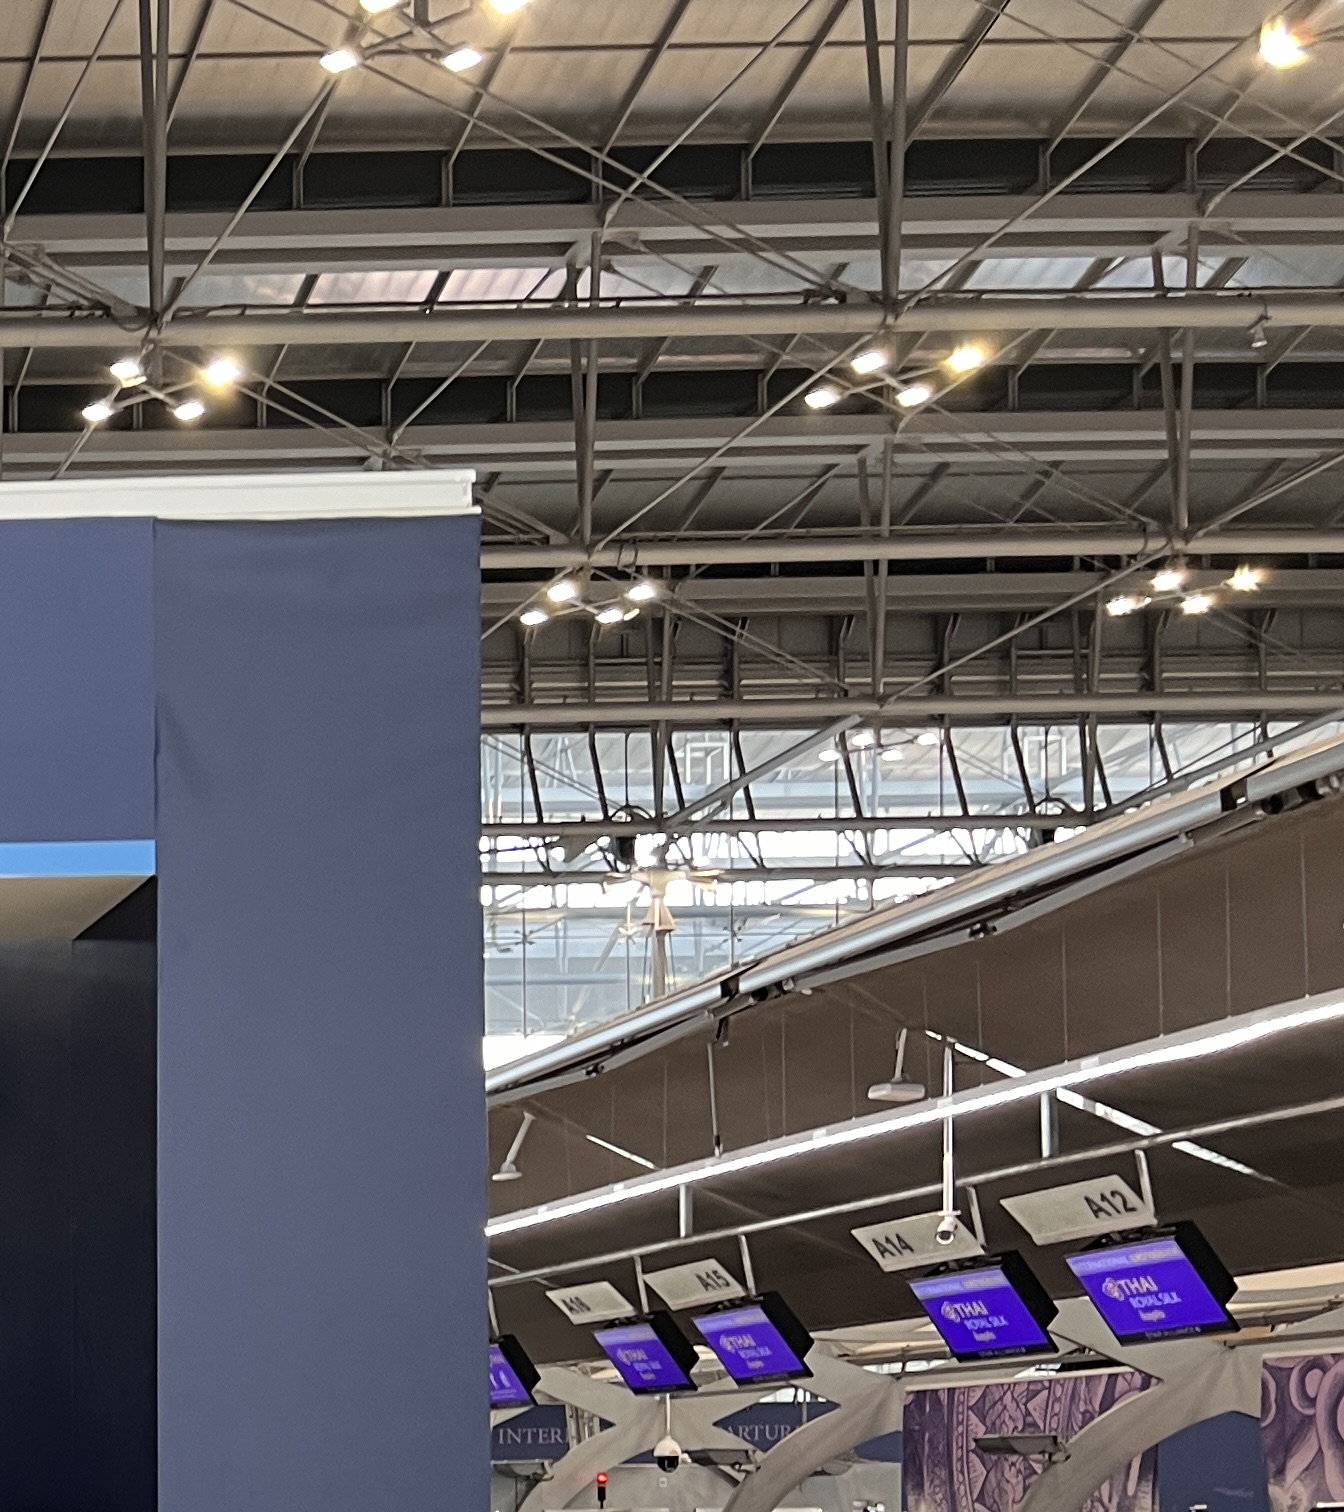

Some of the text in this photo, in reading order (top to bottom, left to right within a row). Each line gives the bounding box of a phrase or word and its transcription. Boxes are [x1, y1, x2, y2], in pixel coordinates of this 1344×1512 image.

[1083, 1189, 1138, 1220] A12
[871, 1233, 915, 1259] A14
[498, 1427, 569, 1445] INTER
